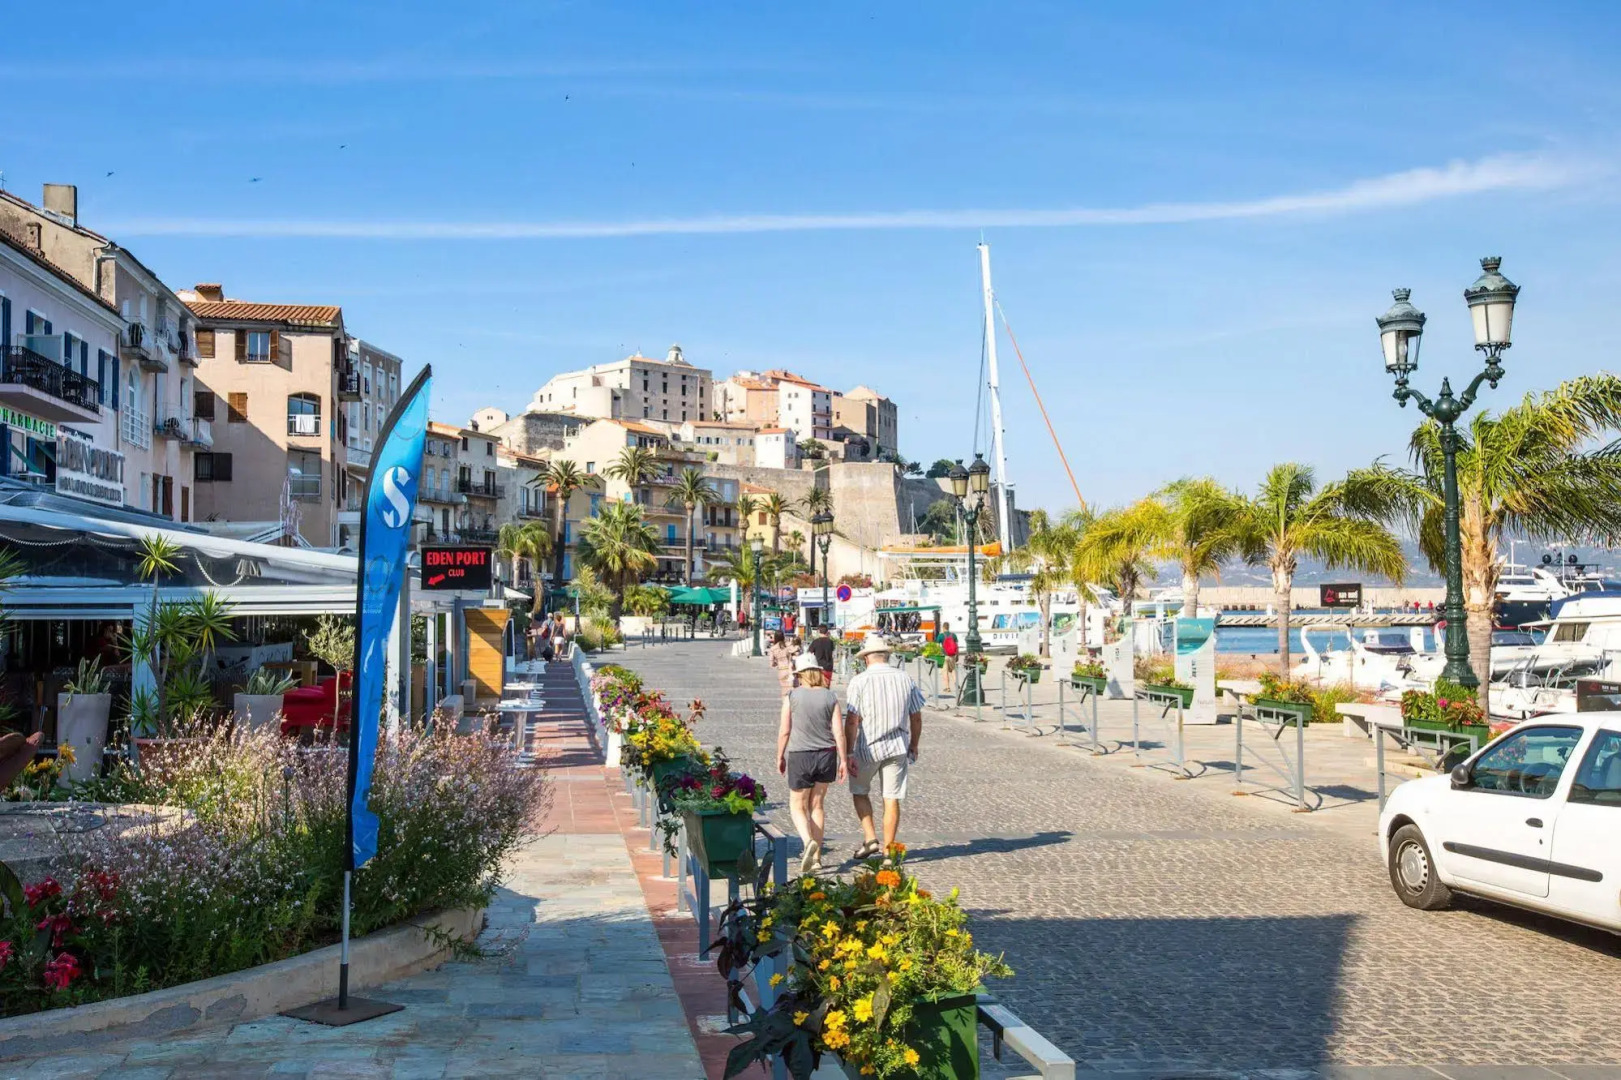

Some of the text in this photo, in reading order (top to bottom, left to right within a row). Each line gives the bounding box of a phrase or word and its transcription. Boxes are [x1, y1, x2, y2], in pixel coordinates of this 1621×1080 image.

[426, 550, 486, 566] EDEN PORT
[448, 568, 465, 577] CLUB
